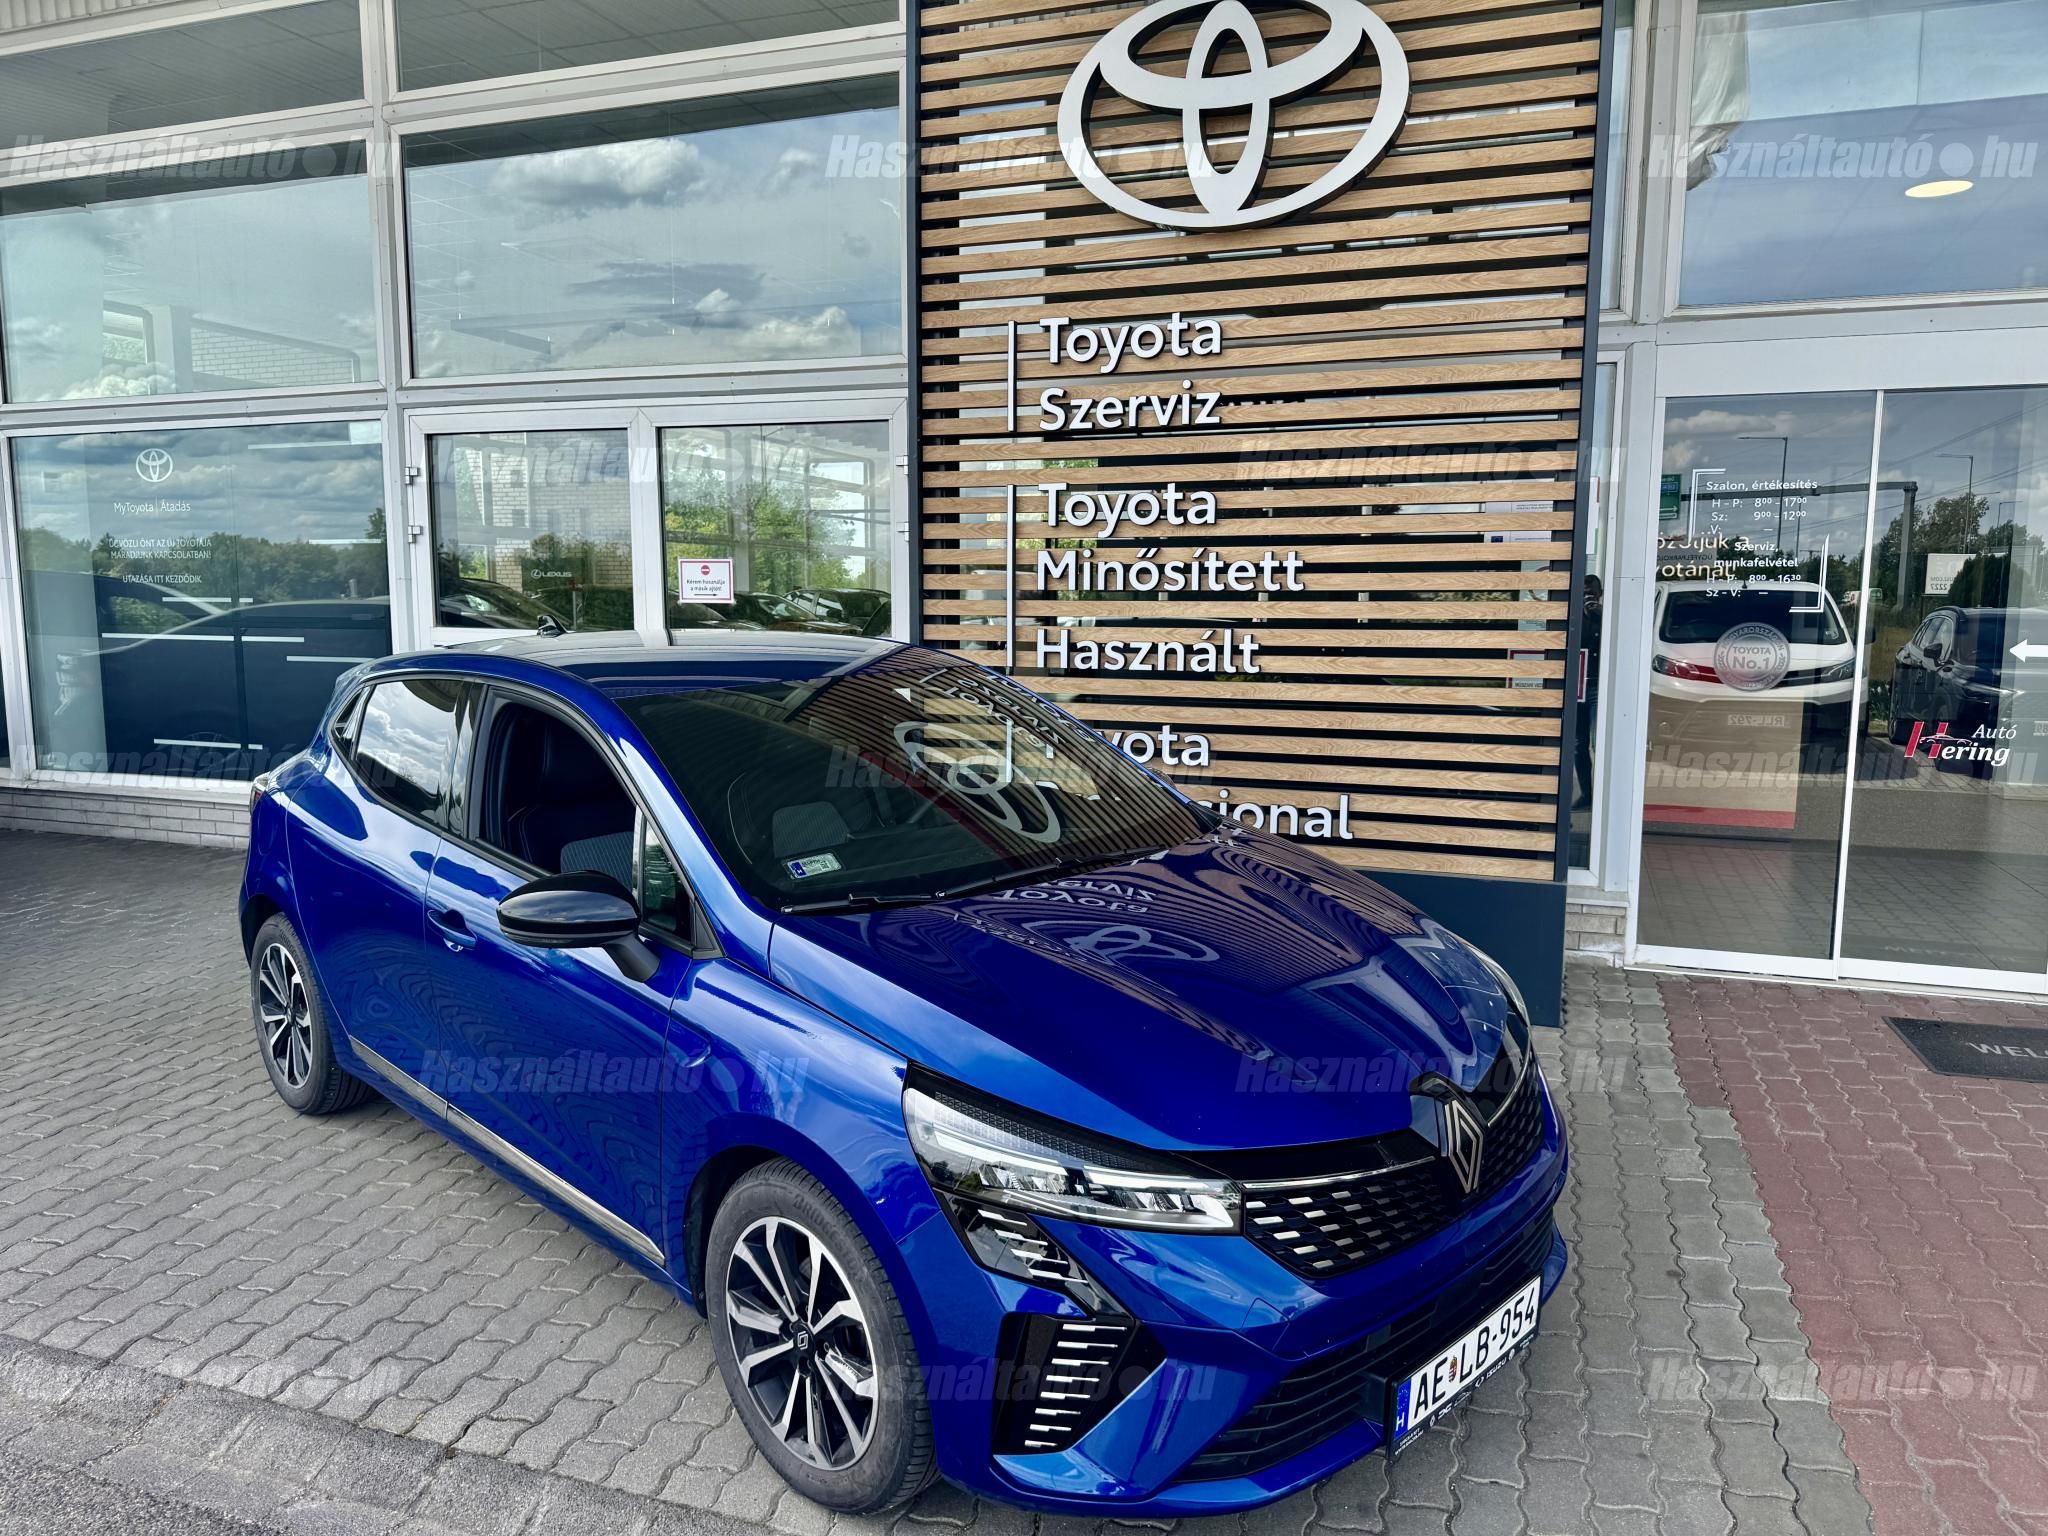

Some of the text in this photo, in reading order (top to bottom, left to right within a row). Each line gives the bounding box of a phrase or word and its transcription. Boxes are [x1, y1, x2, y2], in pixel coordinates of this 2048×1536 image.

[1039, 311, 1222, 373] Toyota
[1039, 379, 1222, 431] Szerviz
[1706, 479, 1818, 491] Szalon, értékesítés
[113, 499, 191, 515] MyToyota Átadás
[1037, 482, 1217, 538] Toyota
[1712, 499, 1721, 508] H
[1732, 499, 1743, 508] P:
[1711, 512, 1728, 521] Sz:
[1036, 546, 1305, 592] Minősített
[1714, 557, 1799, 568] munkafelvétel
[1705, 588, 1719, 597] Sz
[1036, 628, 1262, 674] Használt
[1733, 646, 1771, 655] TOYOTA
[1732, 656, 1770, 670] No.1
[1972, 723, 2018, 740] Autó
[1904, 721, 2010, 767] Hering
[1968, 1041, 2048, 1059] WEL
[1414, 1287, 1535, 1419] AE LB-954
